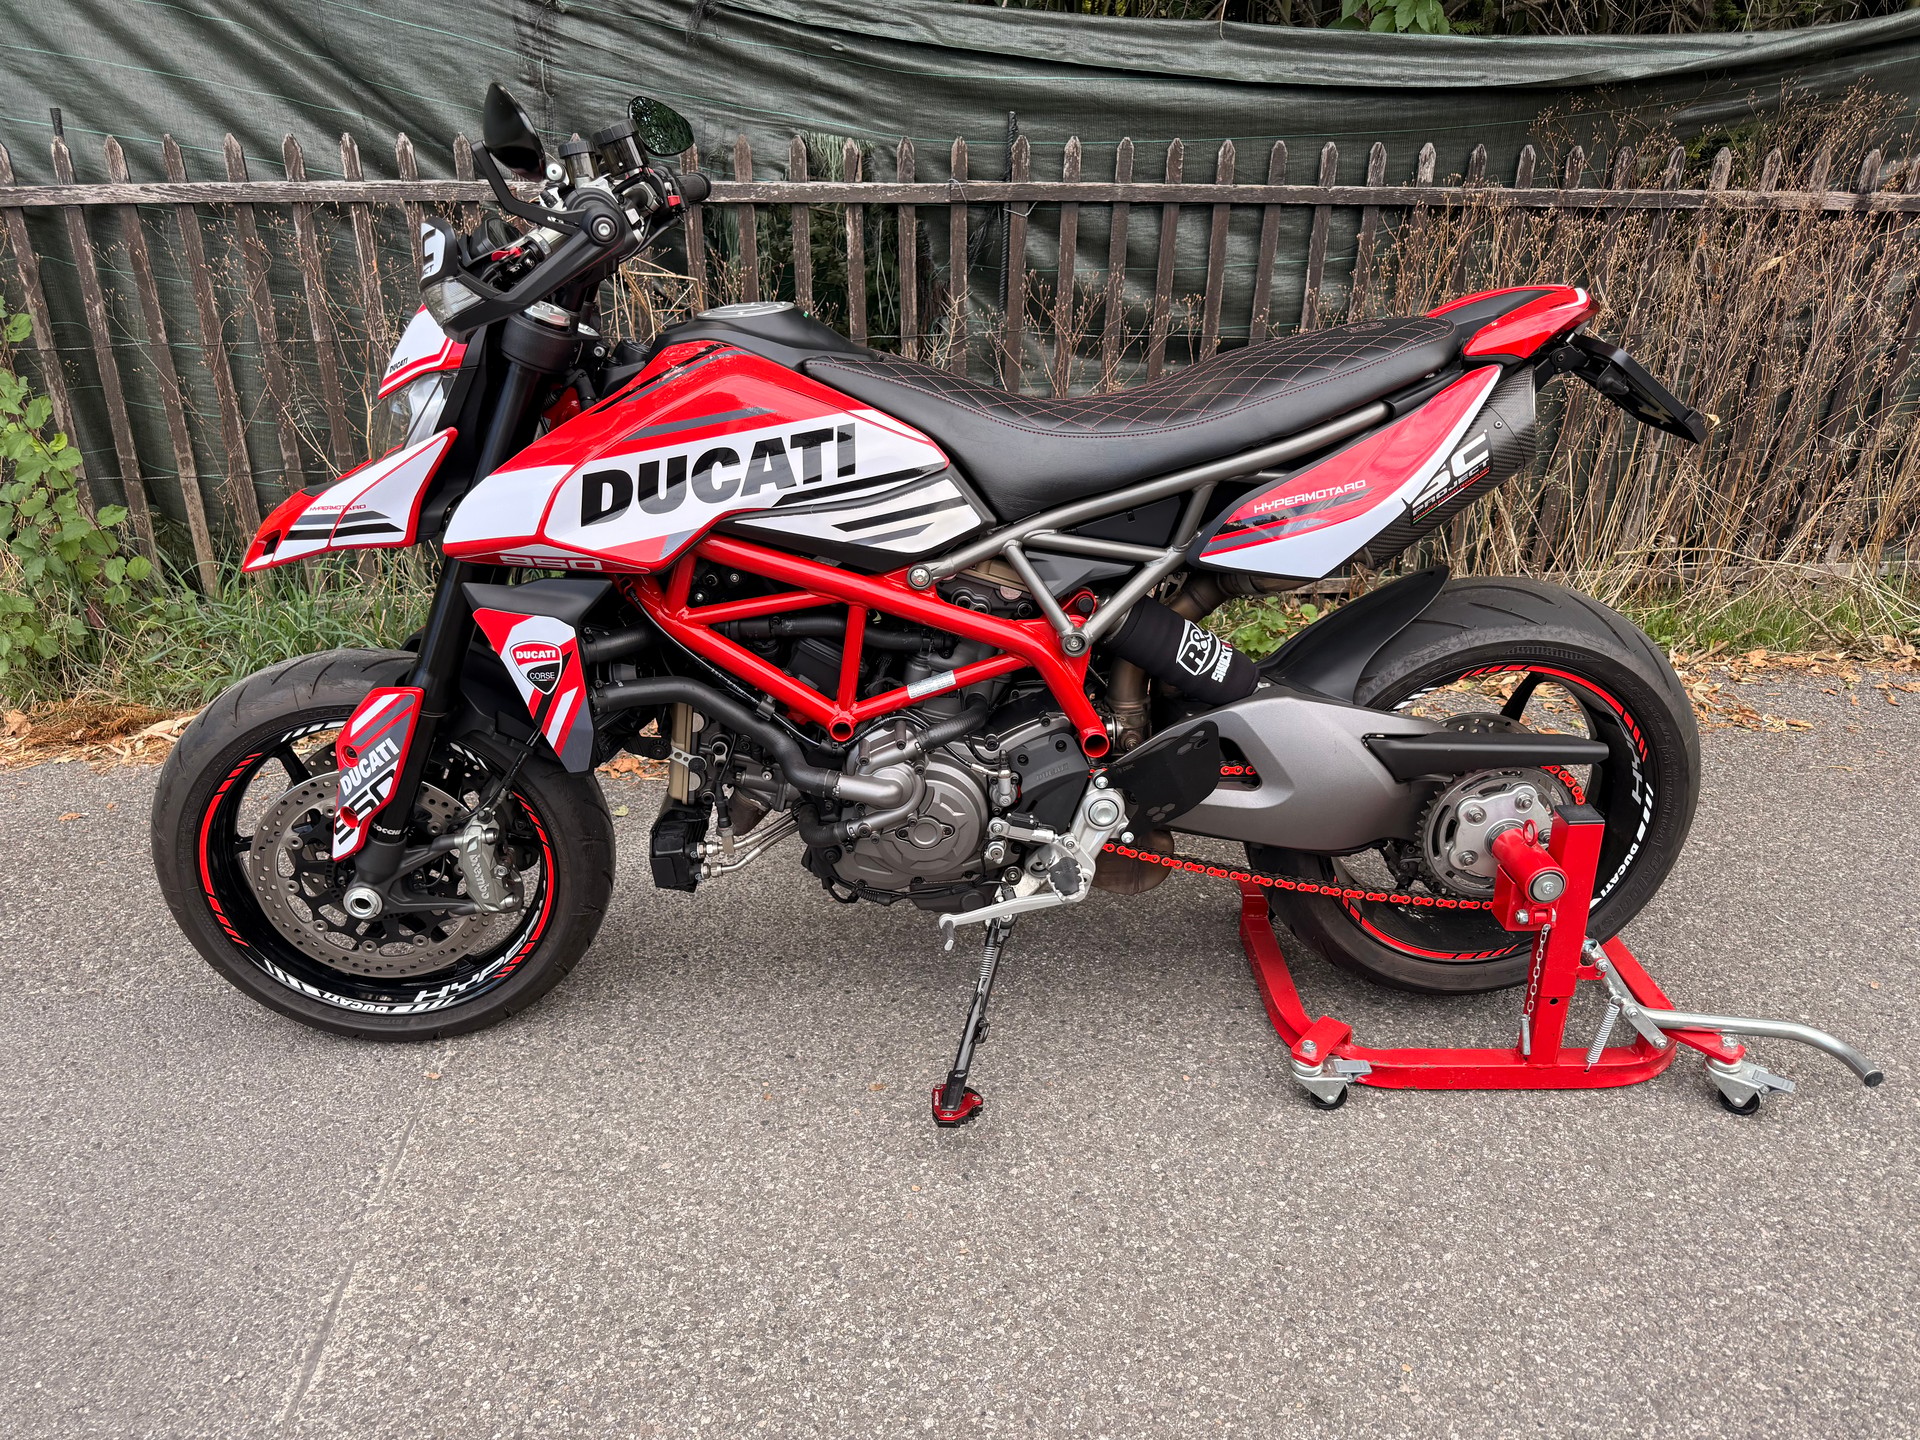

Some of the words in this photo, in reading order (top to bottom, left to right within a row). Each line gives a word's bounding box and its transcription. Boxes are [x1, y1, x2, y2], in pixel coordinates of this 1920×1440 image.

[581, 422, 856, 528] DUCATI
[1412, 457, 1490, 517] PROJECT
[1253, 479, 1367, 514] HYPERMOTARD
[499, 555, 603, 571] 950
[515, 649, 557, 660] DUCATI
[529, 671, 556, 681] CORSE
[339, 737, 400, 797] DUCATI
[469, 854, 490, 900] brembo
[1599, 842, 1640, 898] DUCATI
[321, 991, 389, 1015] DUCATI
